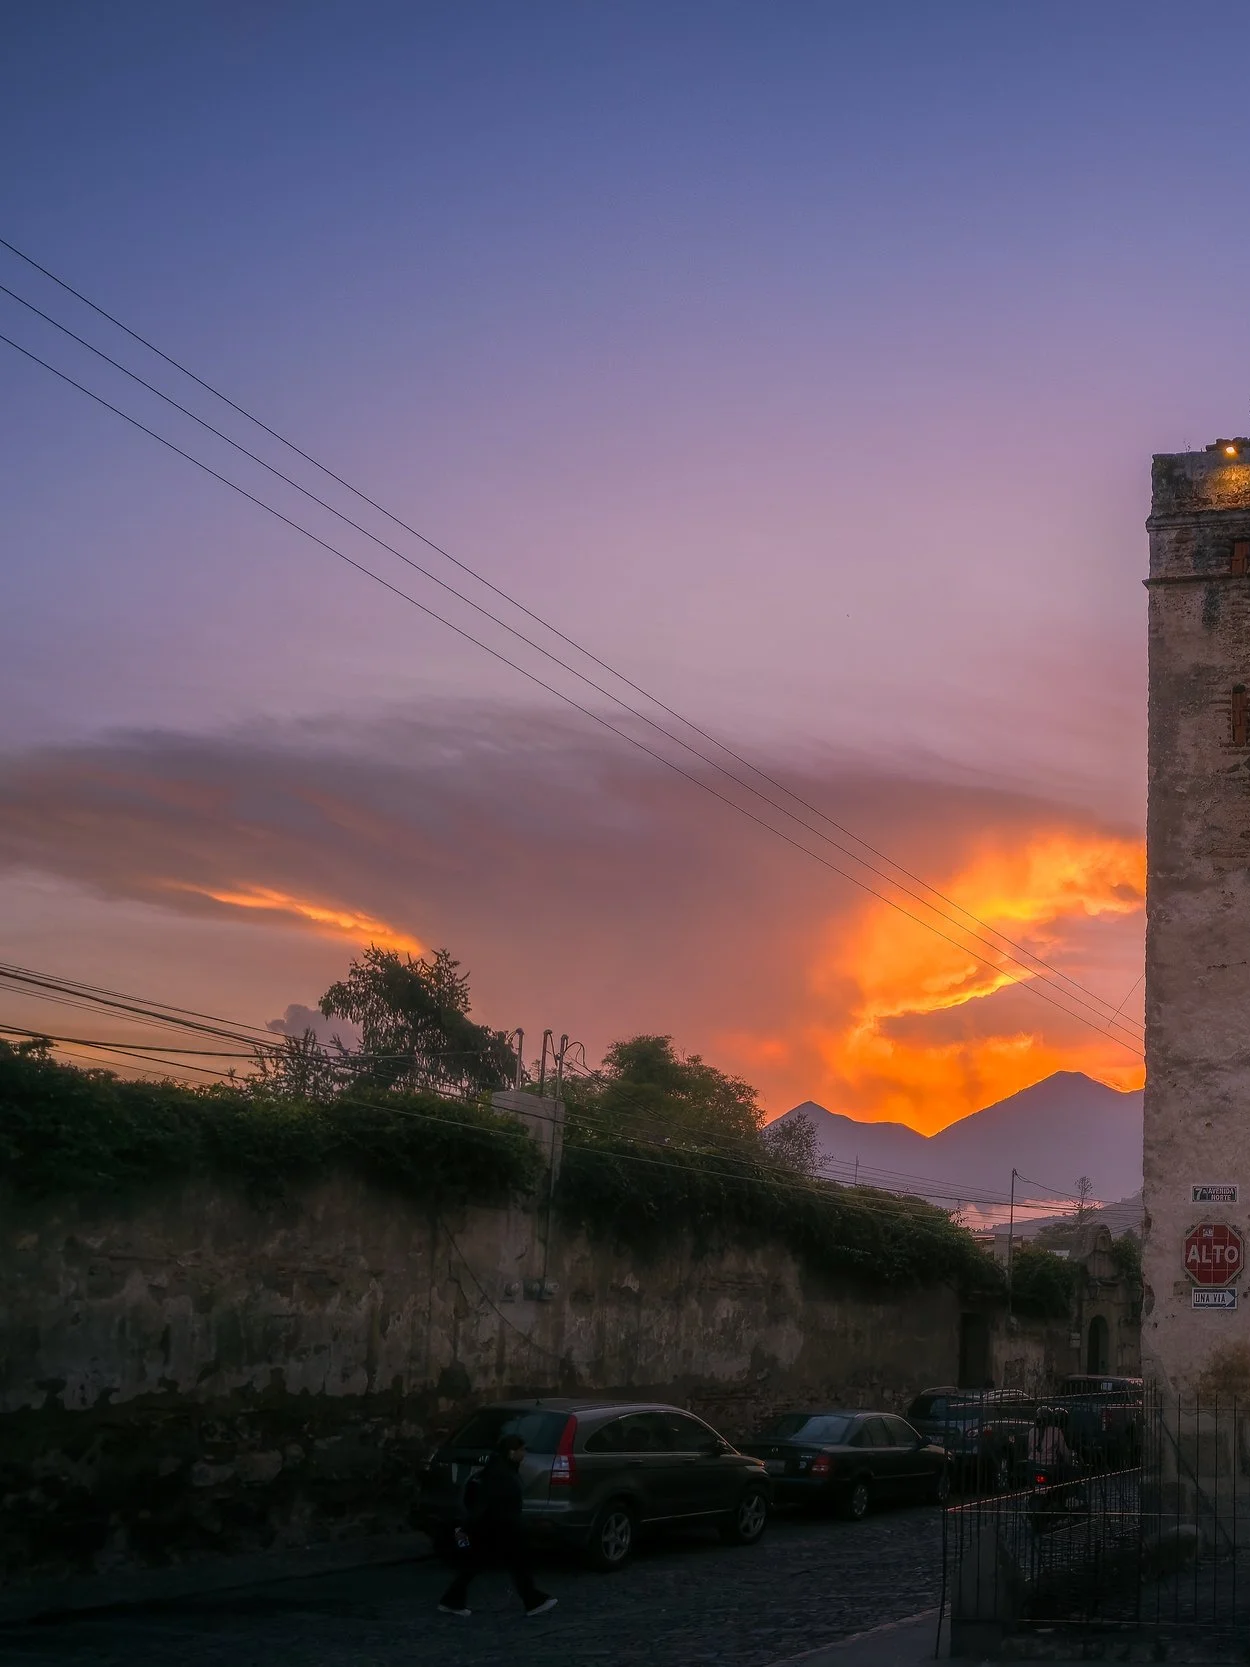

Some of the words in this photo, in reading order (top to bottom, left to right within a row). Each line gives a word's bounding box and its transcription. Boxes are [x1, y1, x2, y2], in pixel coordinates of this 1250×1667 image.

[1208, 1187, 1234, 1195] AVENIDA
[1187, 1244, 1239, 1264] ALTO
[1195, 1293, 1209, 1303] UNA
[1213, 1293, 1226, 1303] VIA
